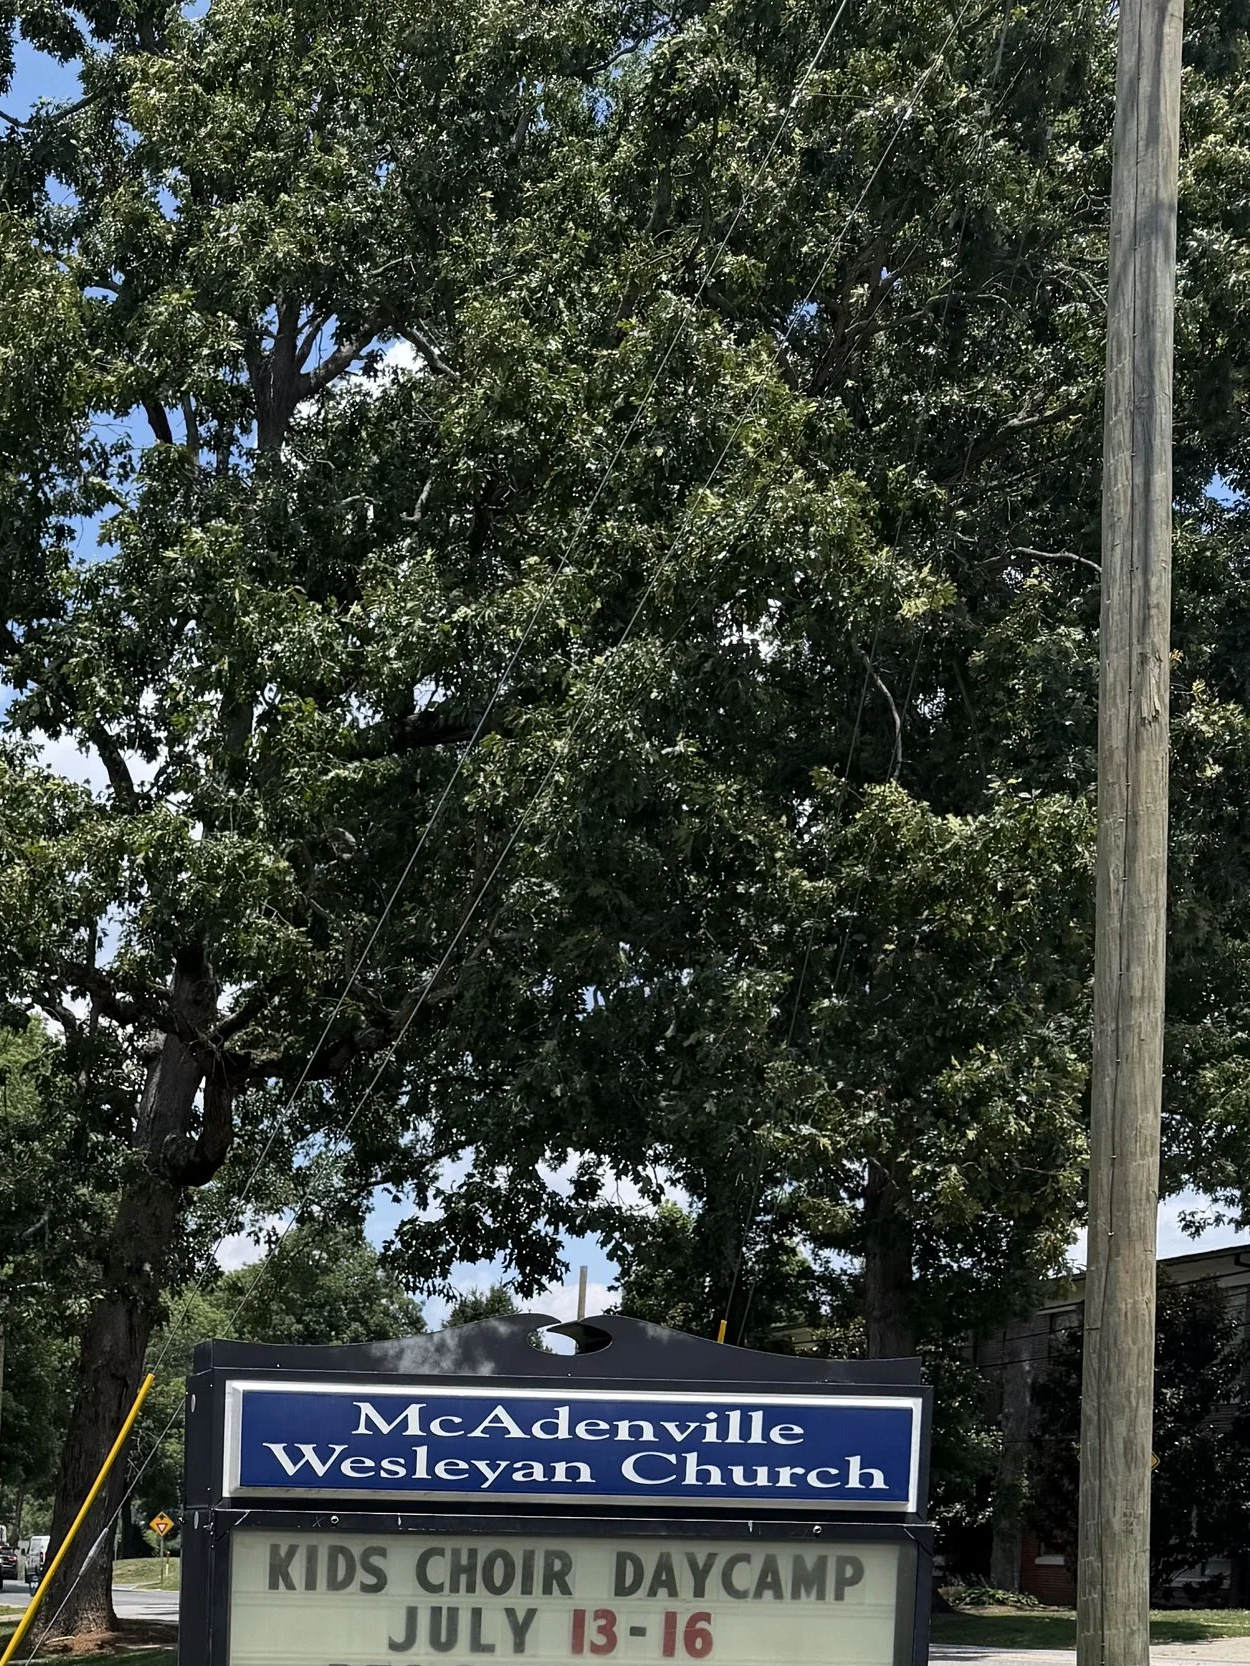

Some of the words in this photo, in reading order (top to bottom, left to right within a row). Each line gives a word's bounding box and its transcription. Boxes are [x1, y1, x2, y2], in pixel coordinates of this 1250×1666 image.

[351, 1401, 805, 1445] McAdenville
[262, 1442, 596, 1489] Wesleyan
[620, 1451, 889, 1489] Church
[268, 1543, 388, 1593] KIDS
[415, 1547, 573, 1595] CHOIR
[614, 1551, 864, 1601] DAYCAMP
[388, 1605, 538, 1654] JULY
